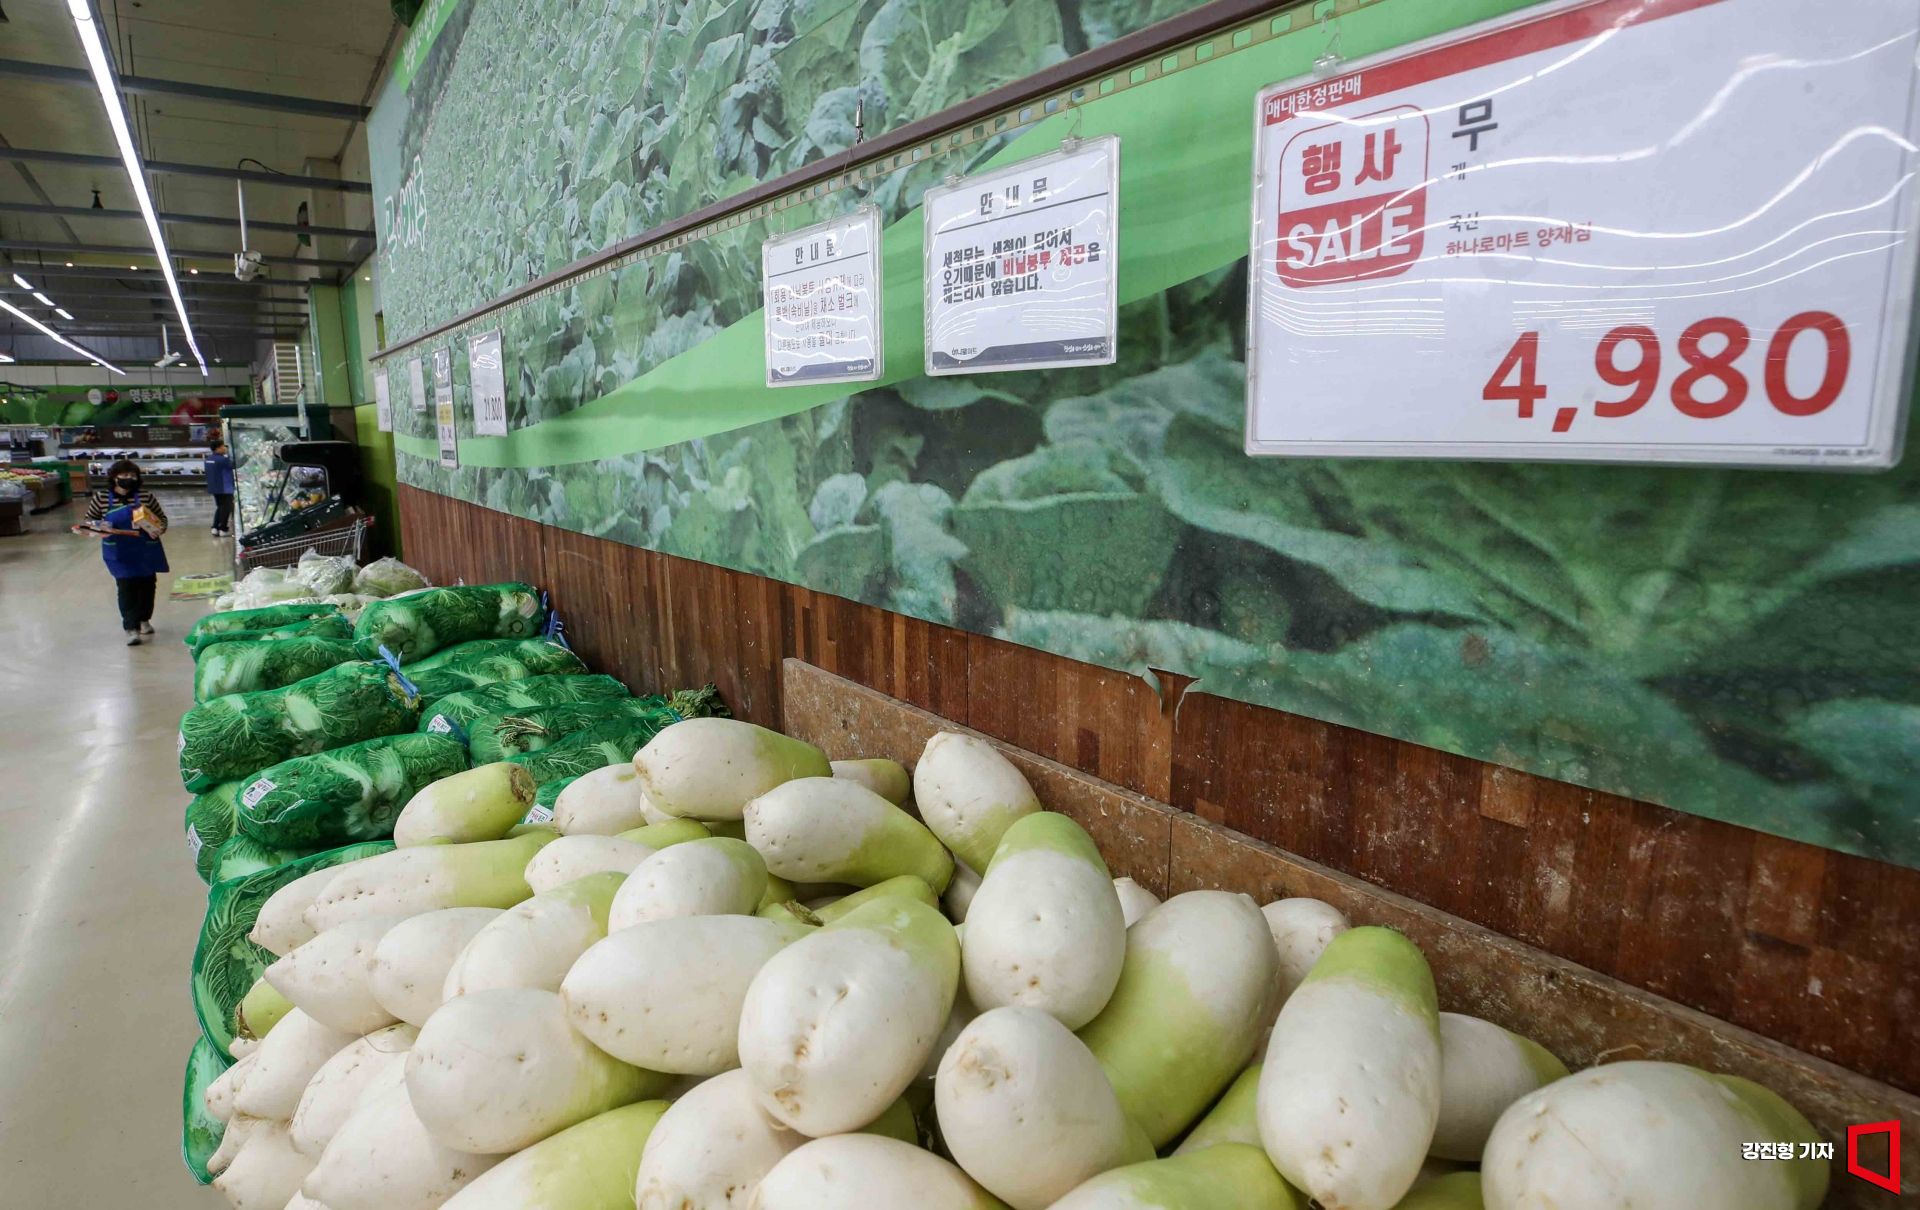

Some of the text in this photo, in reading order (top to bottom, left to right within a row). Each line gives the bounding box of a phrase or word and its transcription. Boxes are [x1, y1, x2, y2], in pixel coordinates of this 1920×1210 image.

[1266, 74, 1361, 118] 매대한정판매
[1452, 98, 1498, 152] 무
[1302, 128, 1402, 196] 행사
[943, 228, 1072, 268] 세척무는 세척이 되어서
[1286, 204, 1413, 270] SALE
[1446, 231, 1530, 257] 하나로마트
[1003, 250, 1051, 277] 비닐봉투
[1482, 310, 1851, 433] 4,980
